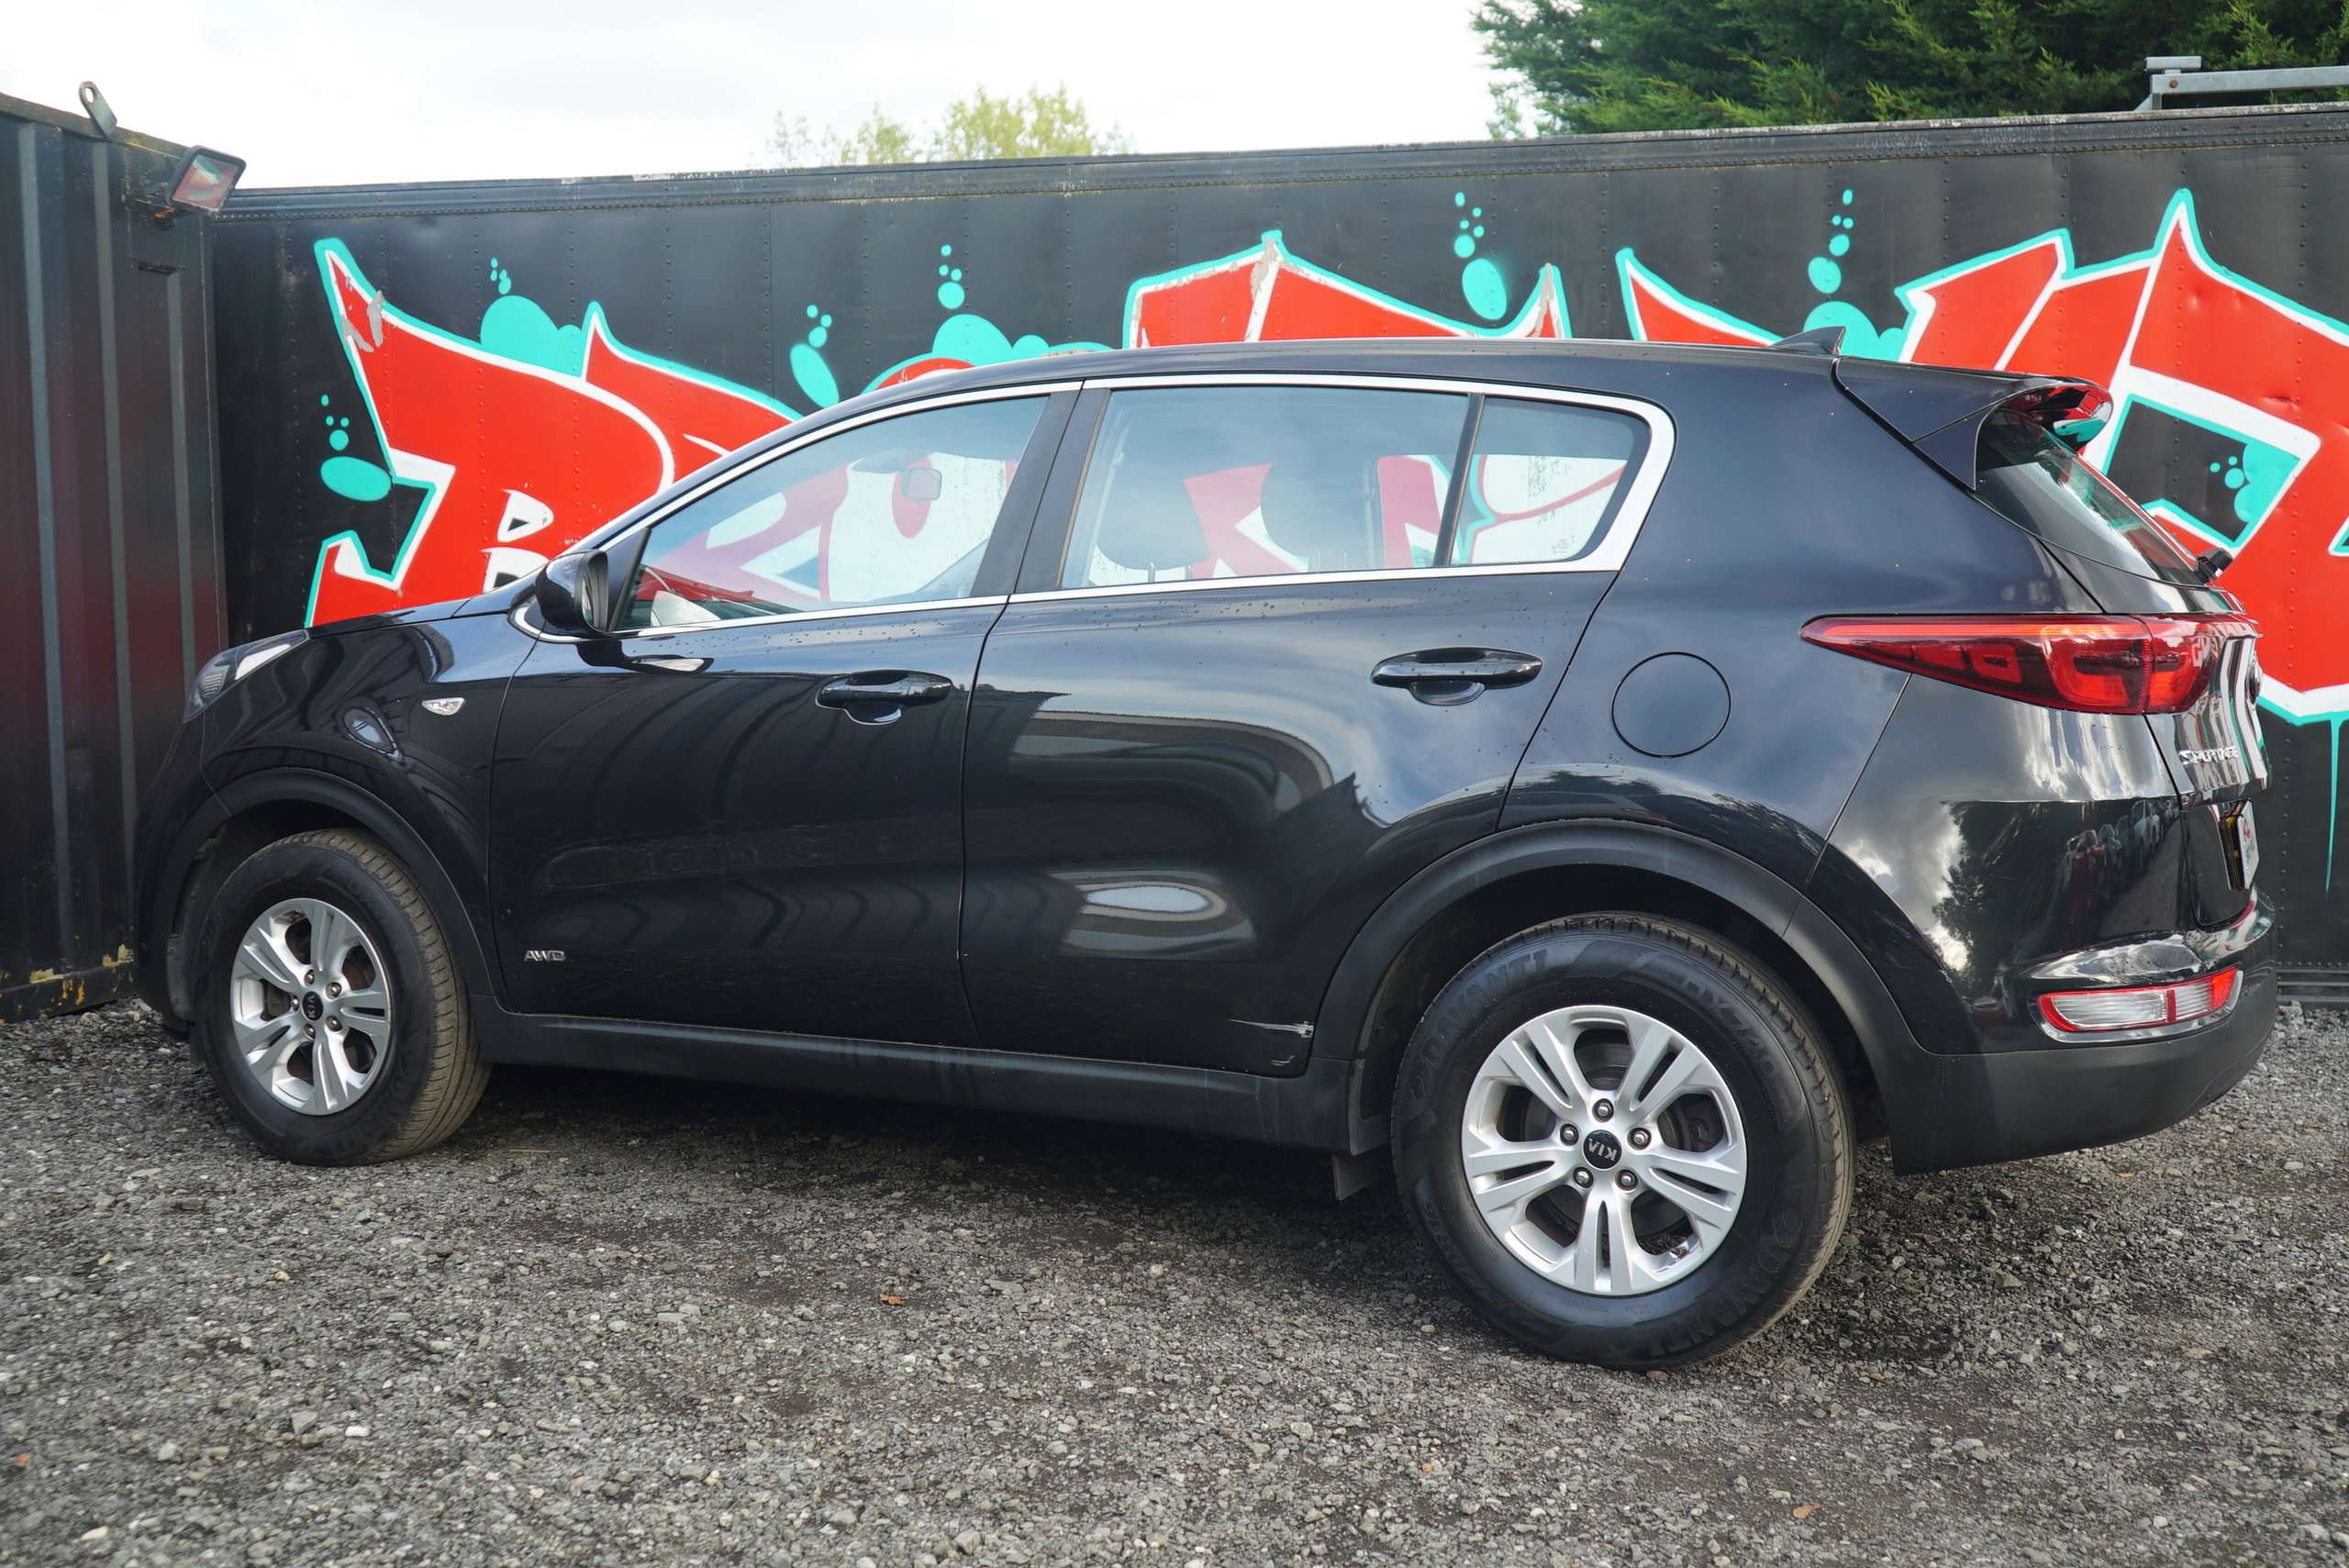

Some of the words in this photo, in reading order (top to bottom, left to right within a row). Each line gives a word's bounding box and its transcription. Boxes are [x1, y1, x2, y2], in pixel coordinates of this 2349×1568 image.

[524, 950, 566, 962] AWD
[307, 995, 317, 1018] KIA
[1588, 1138, 1618, 1162] KIA
